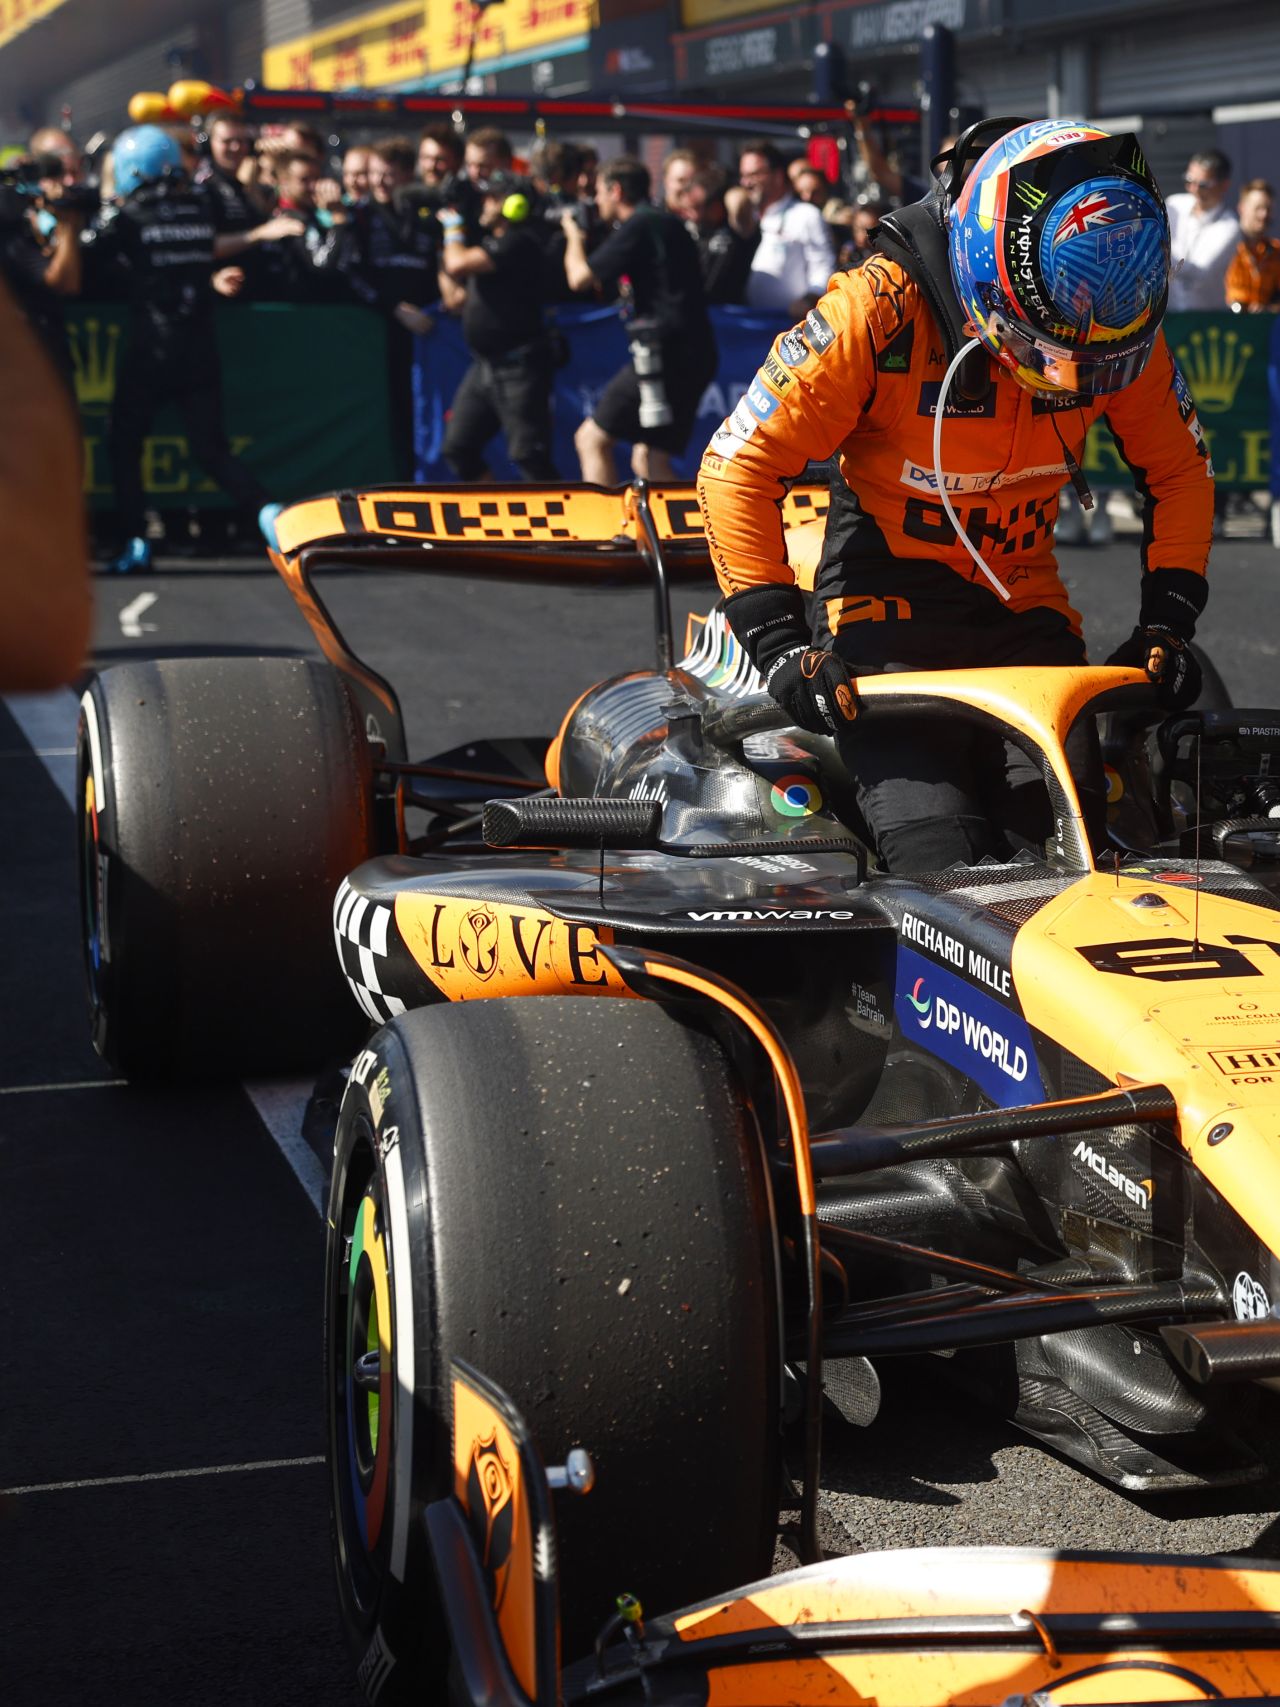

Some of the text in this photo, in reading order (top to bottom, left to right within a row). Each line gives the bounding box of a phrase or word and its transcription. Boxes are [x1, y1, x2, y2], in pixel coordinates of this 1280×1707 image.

[1051, 132, 1081, 143] BELL
[1117, 341, 1145, 358] WORLD
[909, 466, 964, 491] DELL
[1252, 727, 1280, 735] PIASTRI
[688, 909, 854, 921] vmware
[902, 912, 1011, 998] RICHARD MILLE
[851, 982, 877, 1006] #Team
[856, 1000, 885, 1026] Bahrain
[936, 996, 1028, 1082] DP WORLD
[1231, 1075, 1273, 1086] FOR
[1073, 1140, 1146, 1210] McLaren
